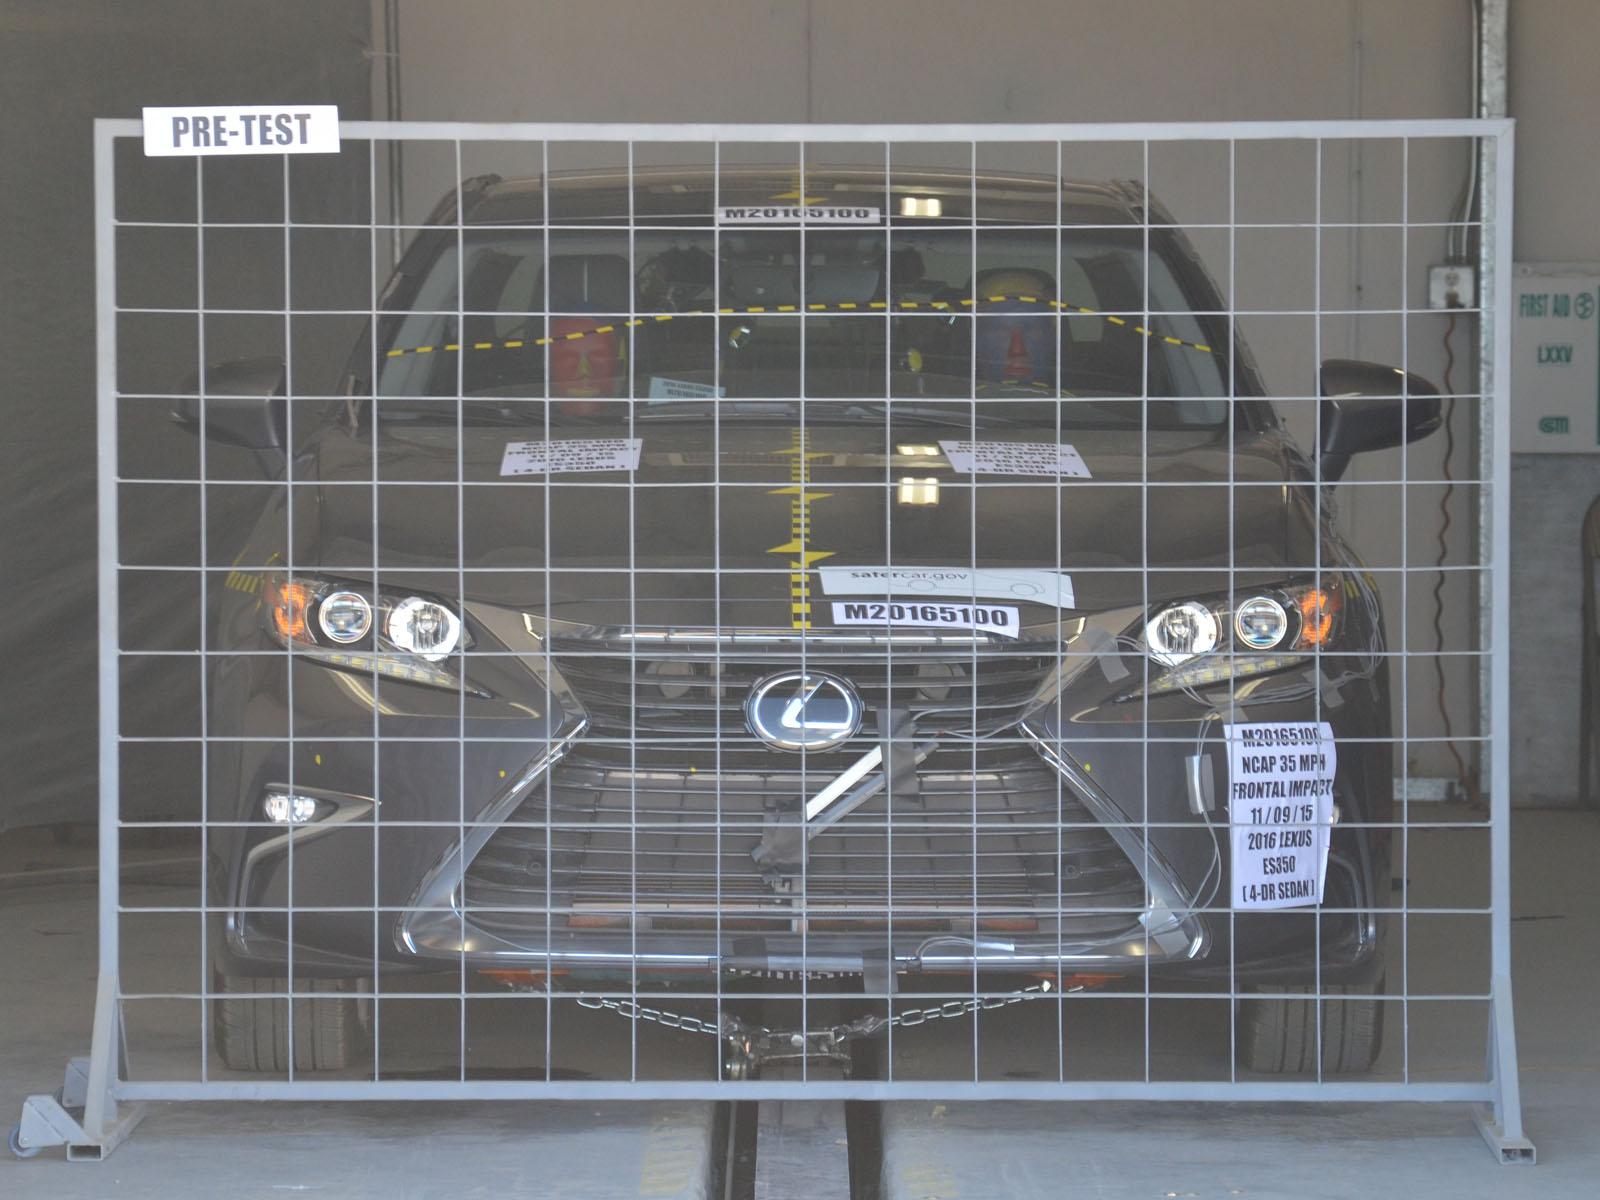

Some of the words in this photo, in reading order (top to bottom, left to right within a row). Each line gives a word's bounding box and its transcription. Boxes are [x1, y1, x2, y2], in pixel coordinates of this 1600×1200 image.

[172, 113, 311, 147] PRE-TEST
[1520, 293, 1548, 317] FIRST
[1553, 293, 1569, 317] AID
[844, 604, 1008, 627] M20165100
[1242, 756, 1276, 774] NCAP
[1280, 755, 1296, 772] 35
[1300, 754, 1325, 772] MPH
[1233, 781, 1286, 800] FRONTAL
[1289, 779, 1333, 798] IMPACT
[1248, 832, 1277, 850] 2016
[1279, 829, 1312, 848] LEXUS
[1263, 856, 1296, 875] ES350
